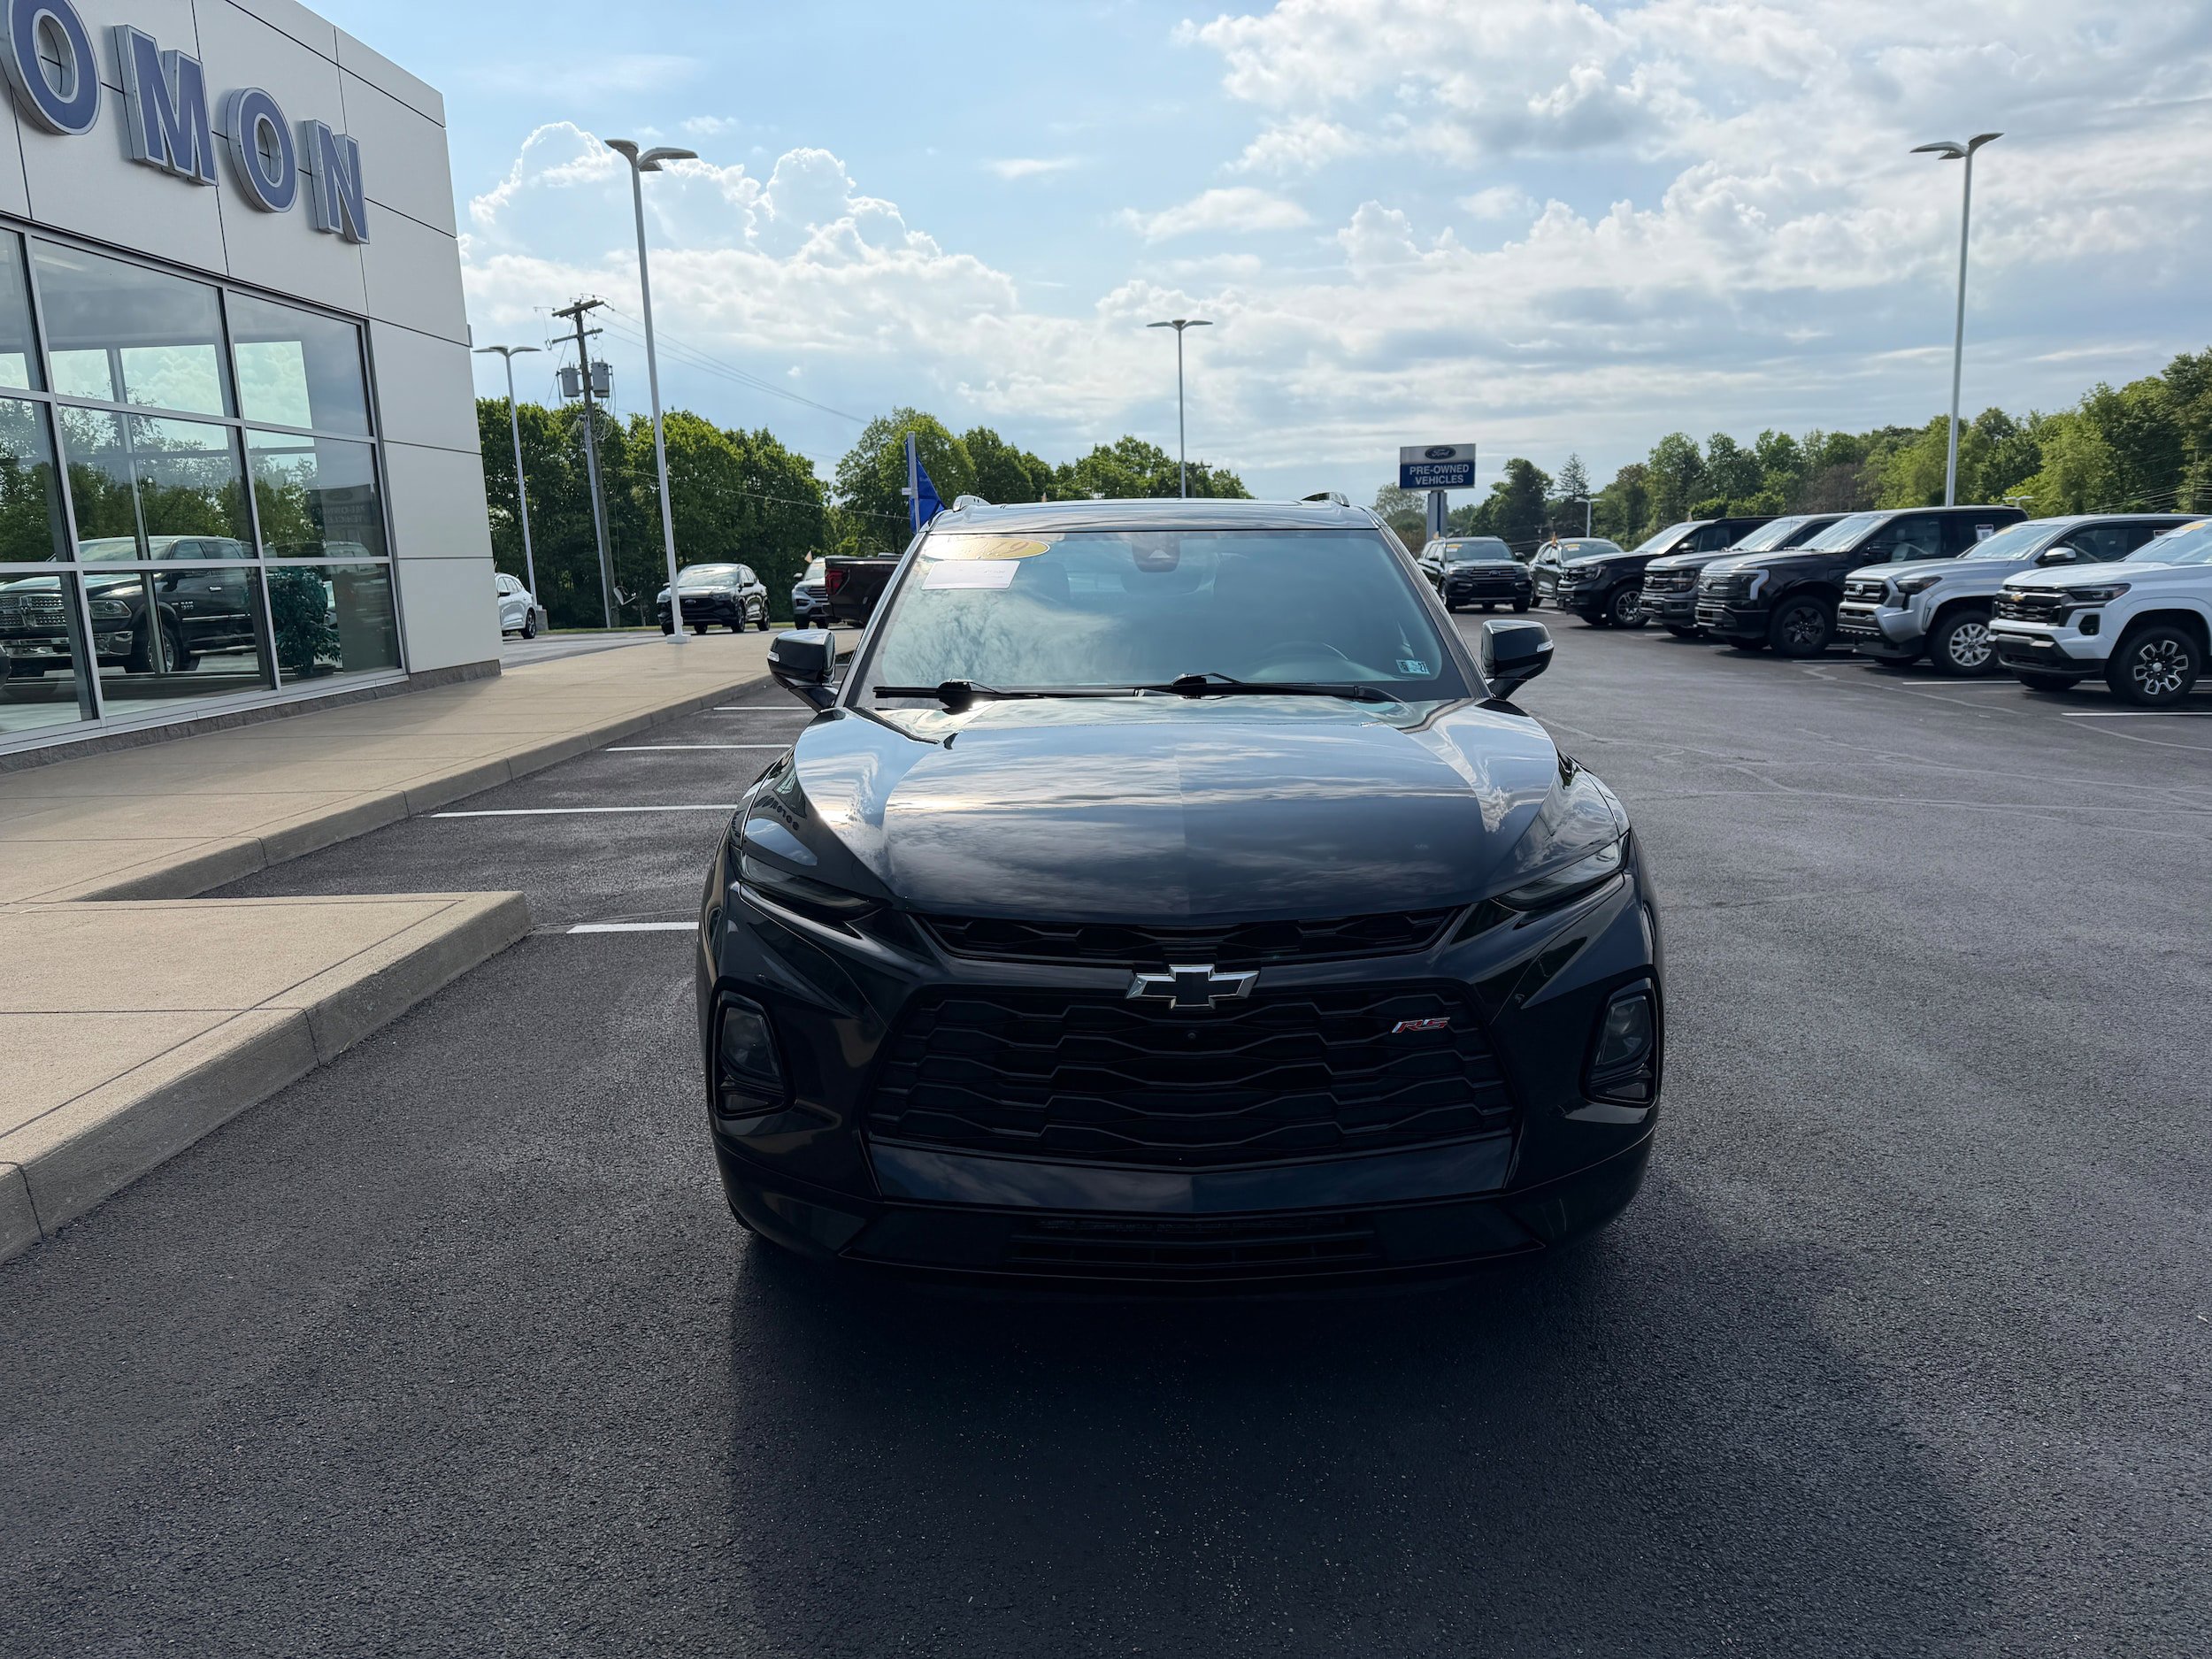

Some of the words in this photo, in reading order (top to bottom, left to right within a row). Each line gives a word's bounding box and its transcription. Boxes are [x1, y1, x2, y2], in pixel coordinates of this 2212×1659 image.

[1409, 465, 1470, 475] PRE-OWNED
[1416, 474, 1464, 485] VEHICLES
[1392, 1017, 1450, 1033] RS
